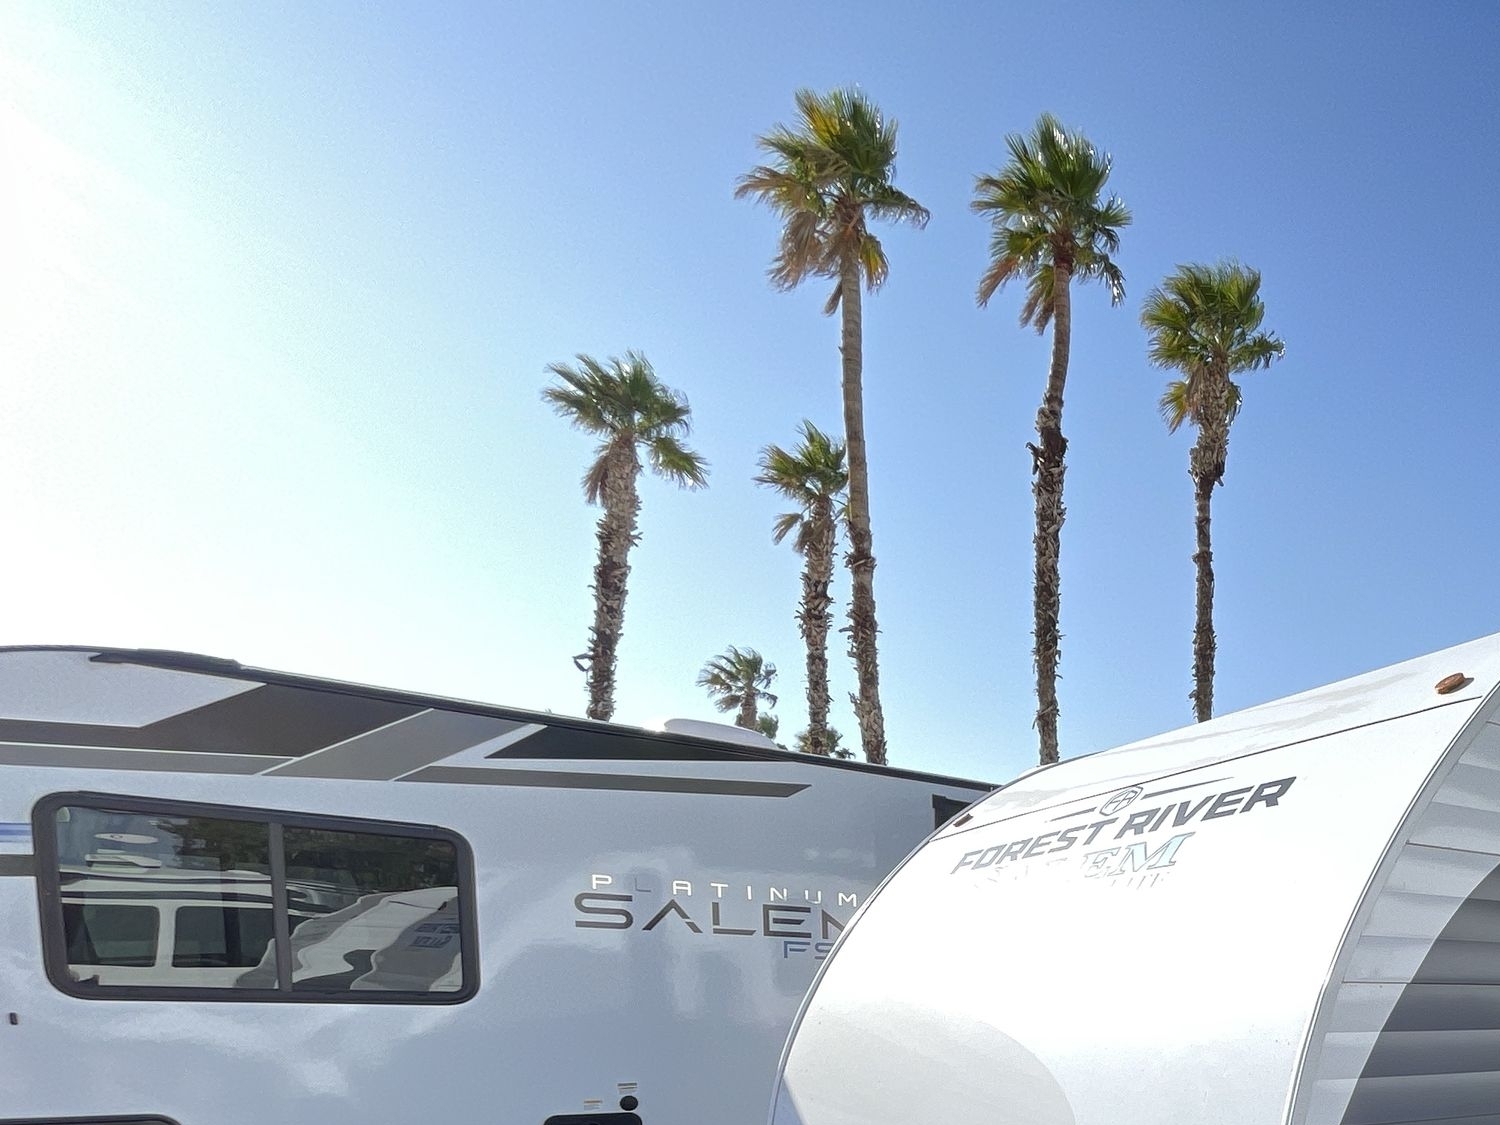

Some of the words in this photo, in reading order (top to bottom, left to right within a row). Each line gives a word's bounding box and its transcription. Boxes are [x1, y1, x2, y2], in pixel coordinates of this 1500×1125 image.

[950, 818, 1117, 875] FOREST
[1113, 777, 1297, 840] RIVER
[591, 874, 857, 908] PLATINUM
